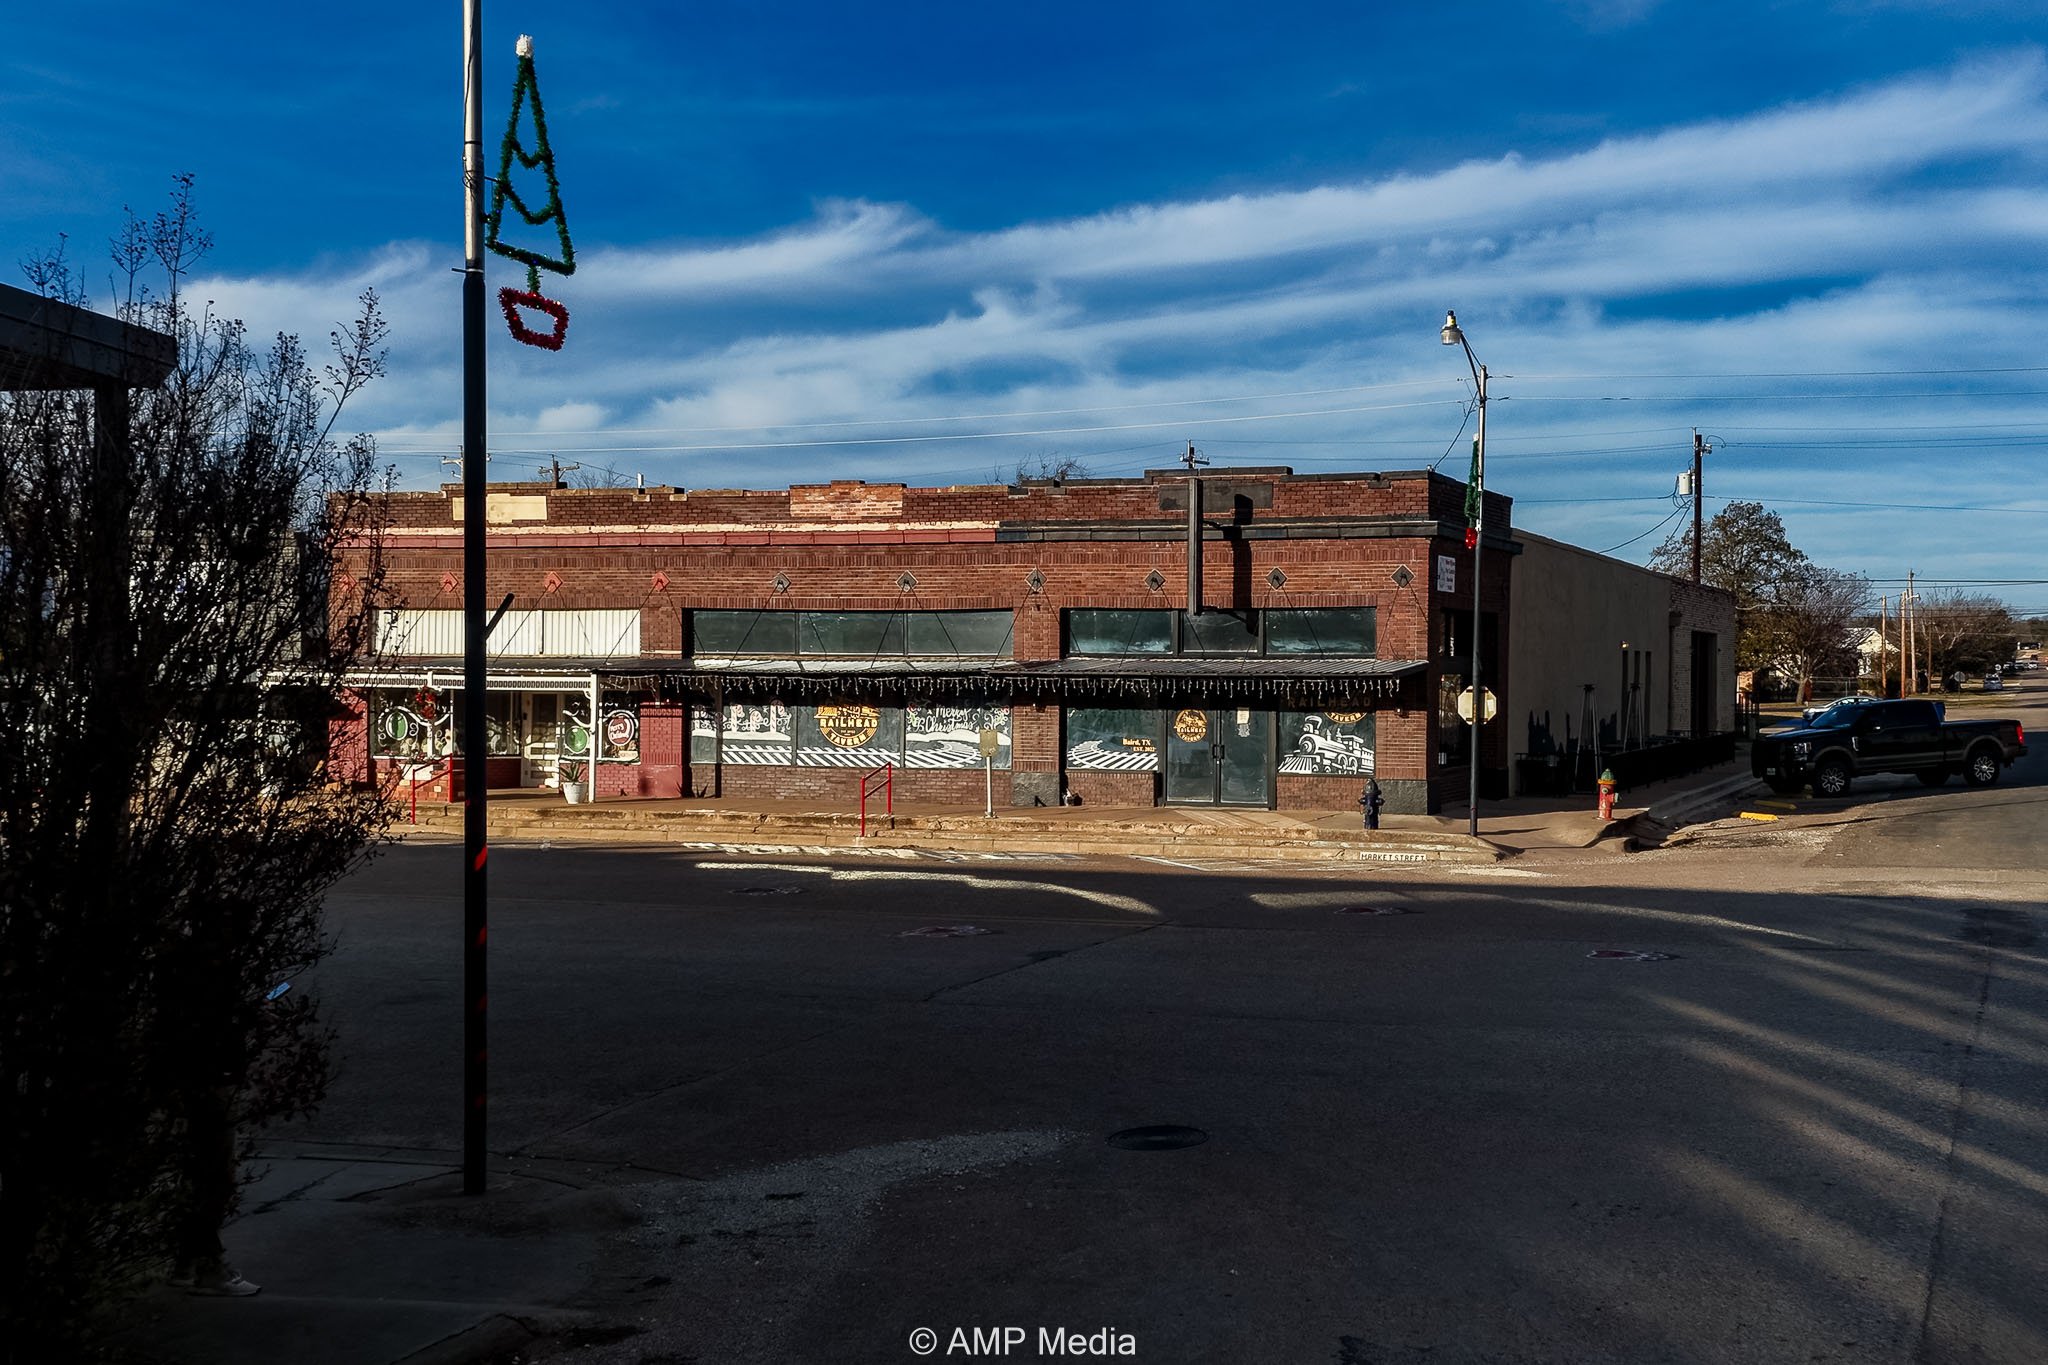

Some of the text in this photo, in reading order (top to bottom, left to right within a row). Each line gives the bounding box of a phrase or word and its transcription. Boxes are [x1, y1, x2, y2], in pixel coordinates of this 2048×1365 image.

[1287, 696, 1372, 708] RAILHEAD
[935, 704, 971, 720] Merry
[819, 717, 878, 728] RAILHEAD
[925, 715, 975, 733] Christmas
[829, 732, 868, 746] TAVERN
[1141, 738, 1151, 746] TX
[1361, 853, 1426, 862] MARKET STREET
